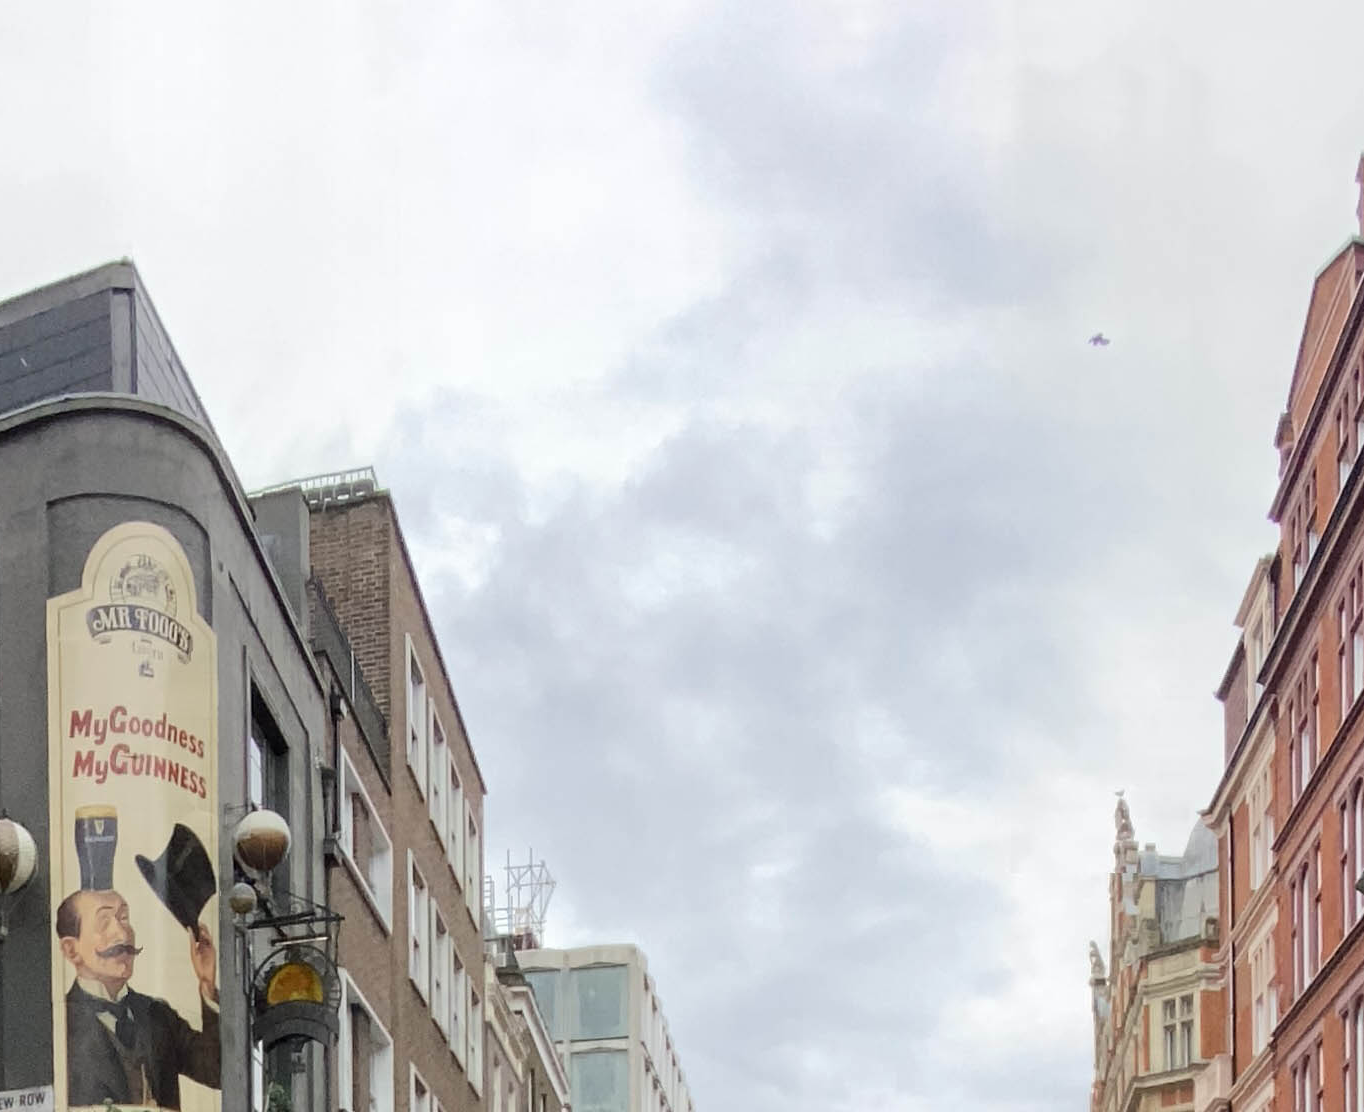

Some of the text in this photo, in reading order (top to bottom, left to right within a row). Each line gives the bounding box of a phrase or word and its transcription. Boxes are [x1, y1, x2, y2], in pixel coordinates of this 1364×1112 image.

[93, 606, 132, 631] MR
[109, 705, 205, 759] Goodness
[110, 743, 208, 800] GUINNESS
[18, 1092, 46, 1107] ROW
